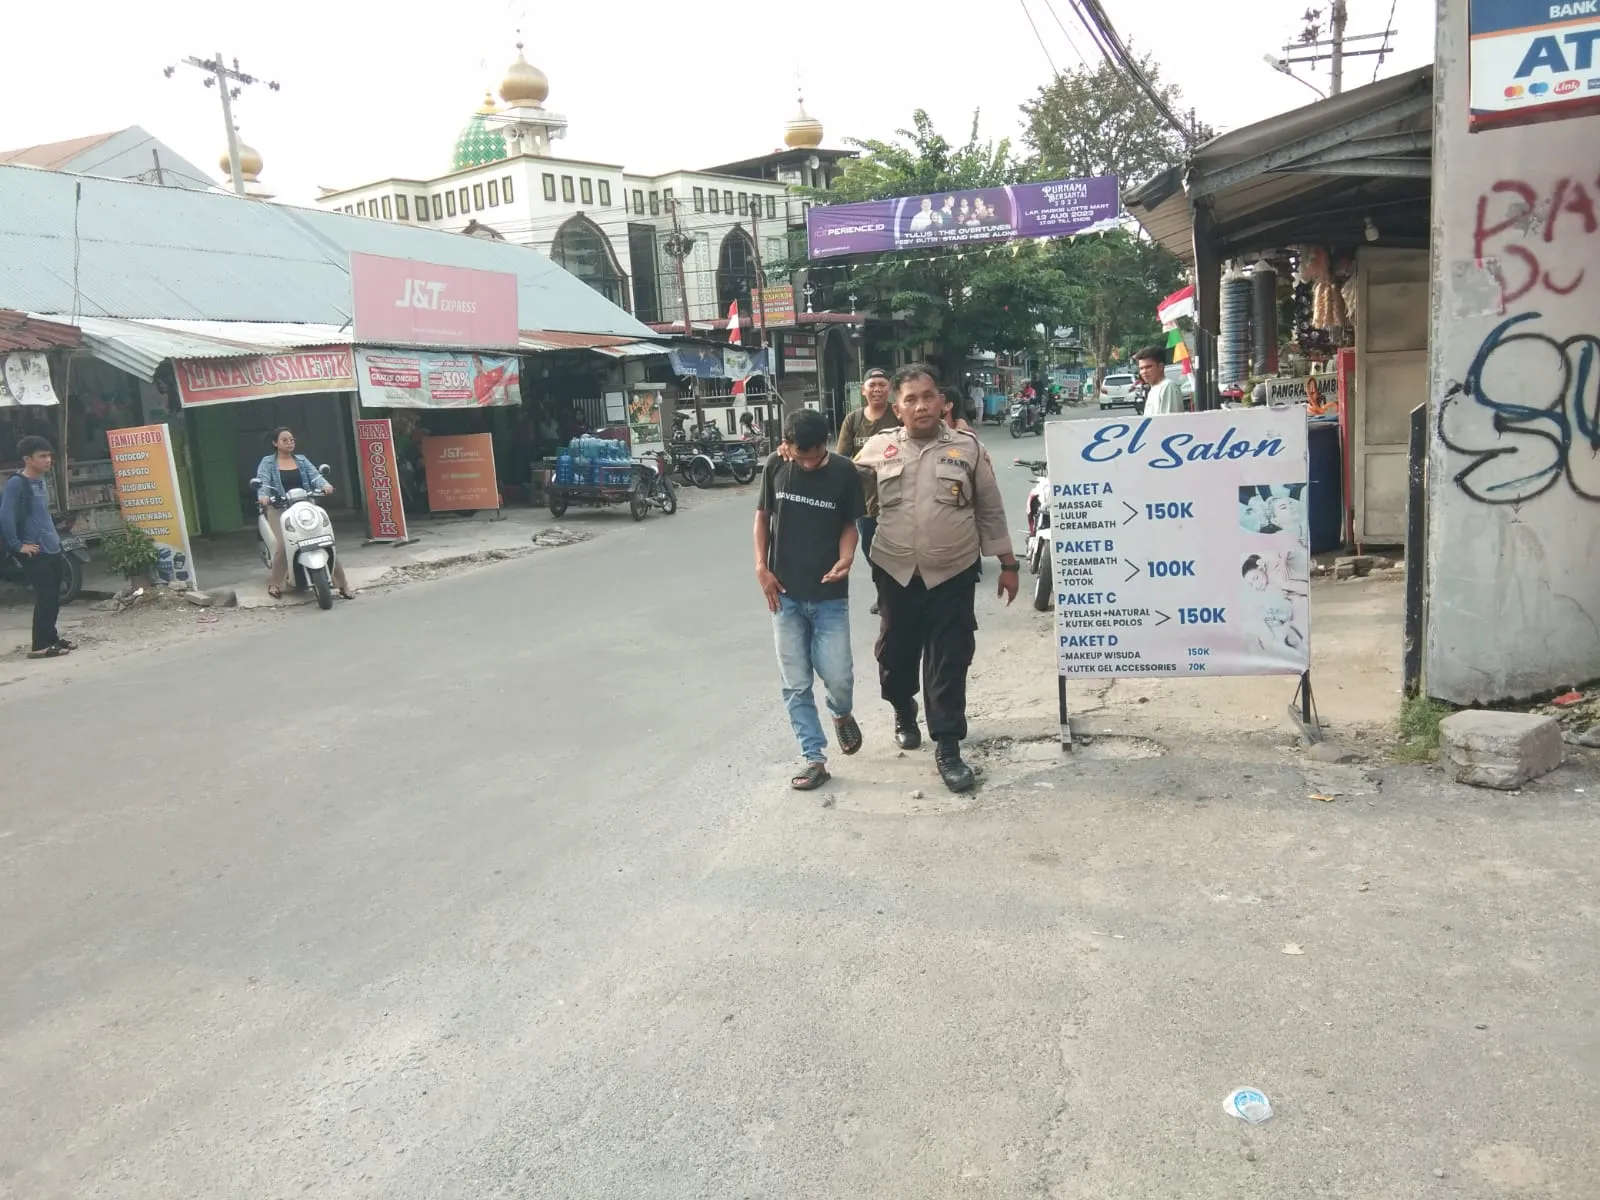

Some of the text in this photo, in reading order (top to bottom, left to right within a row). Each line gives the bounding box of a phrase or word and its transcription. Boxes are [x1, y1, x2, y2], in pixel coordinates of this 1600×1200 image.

[1549, 1, 1598, 19] BANK
[1513, 29, 1600, 79] AT
[1555, 82, 1578, 92] Link
[1042, 183, 1087, 197] PURNAMA
[1071, 210, 1094, 218] 2023
[1474, 175, 1600, 268] PA
[958, 224, 1011, 234] OVERTUNES
[992, 230, 1018, 238] ALONE
[395, 279, 476, 313] J&T EXPRESS
[184, 353, 352, 391] LINA COSMETIK
[443, 371, 470, 387] 30%
[1271, 379, 1338, 398] PANGKA AMB
[111, 431, 162, 448] FAMILY FOTO
[359, 424, 389, 440] LINA
[1081, 418, 1285, 470] El Salon
[369, 442, 397, 535] COSMETIK
[1053, 482, 1113, 496] PAKET A
[1145, 501, 1194, 521] 150K
[1056, 540, 1114, 553] PAKET B
[1147, 560, 1196, 578] 100K
[1058, 592, 1117, 605] PAKET C
[1065, 618, 1143, 628] KUTEK GEL POLOS
[1178, 607, 1227, 625] 150K
[1060, 635, 1119, 647] PAKET D
[1104, 651, 1141, 660] WISUDA
[1188, 647, 1210, 656] 150K
[1067, 663, 1176, 673] KUTEK GEL ACCESSORIES
[1188, 663, 1206, 671] 70K
